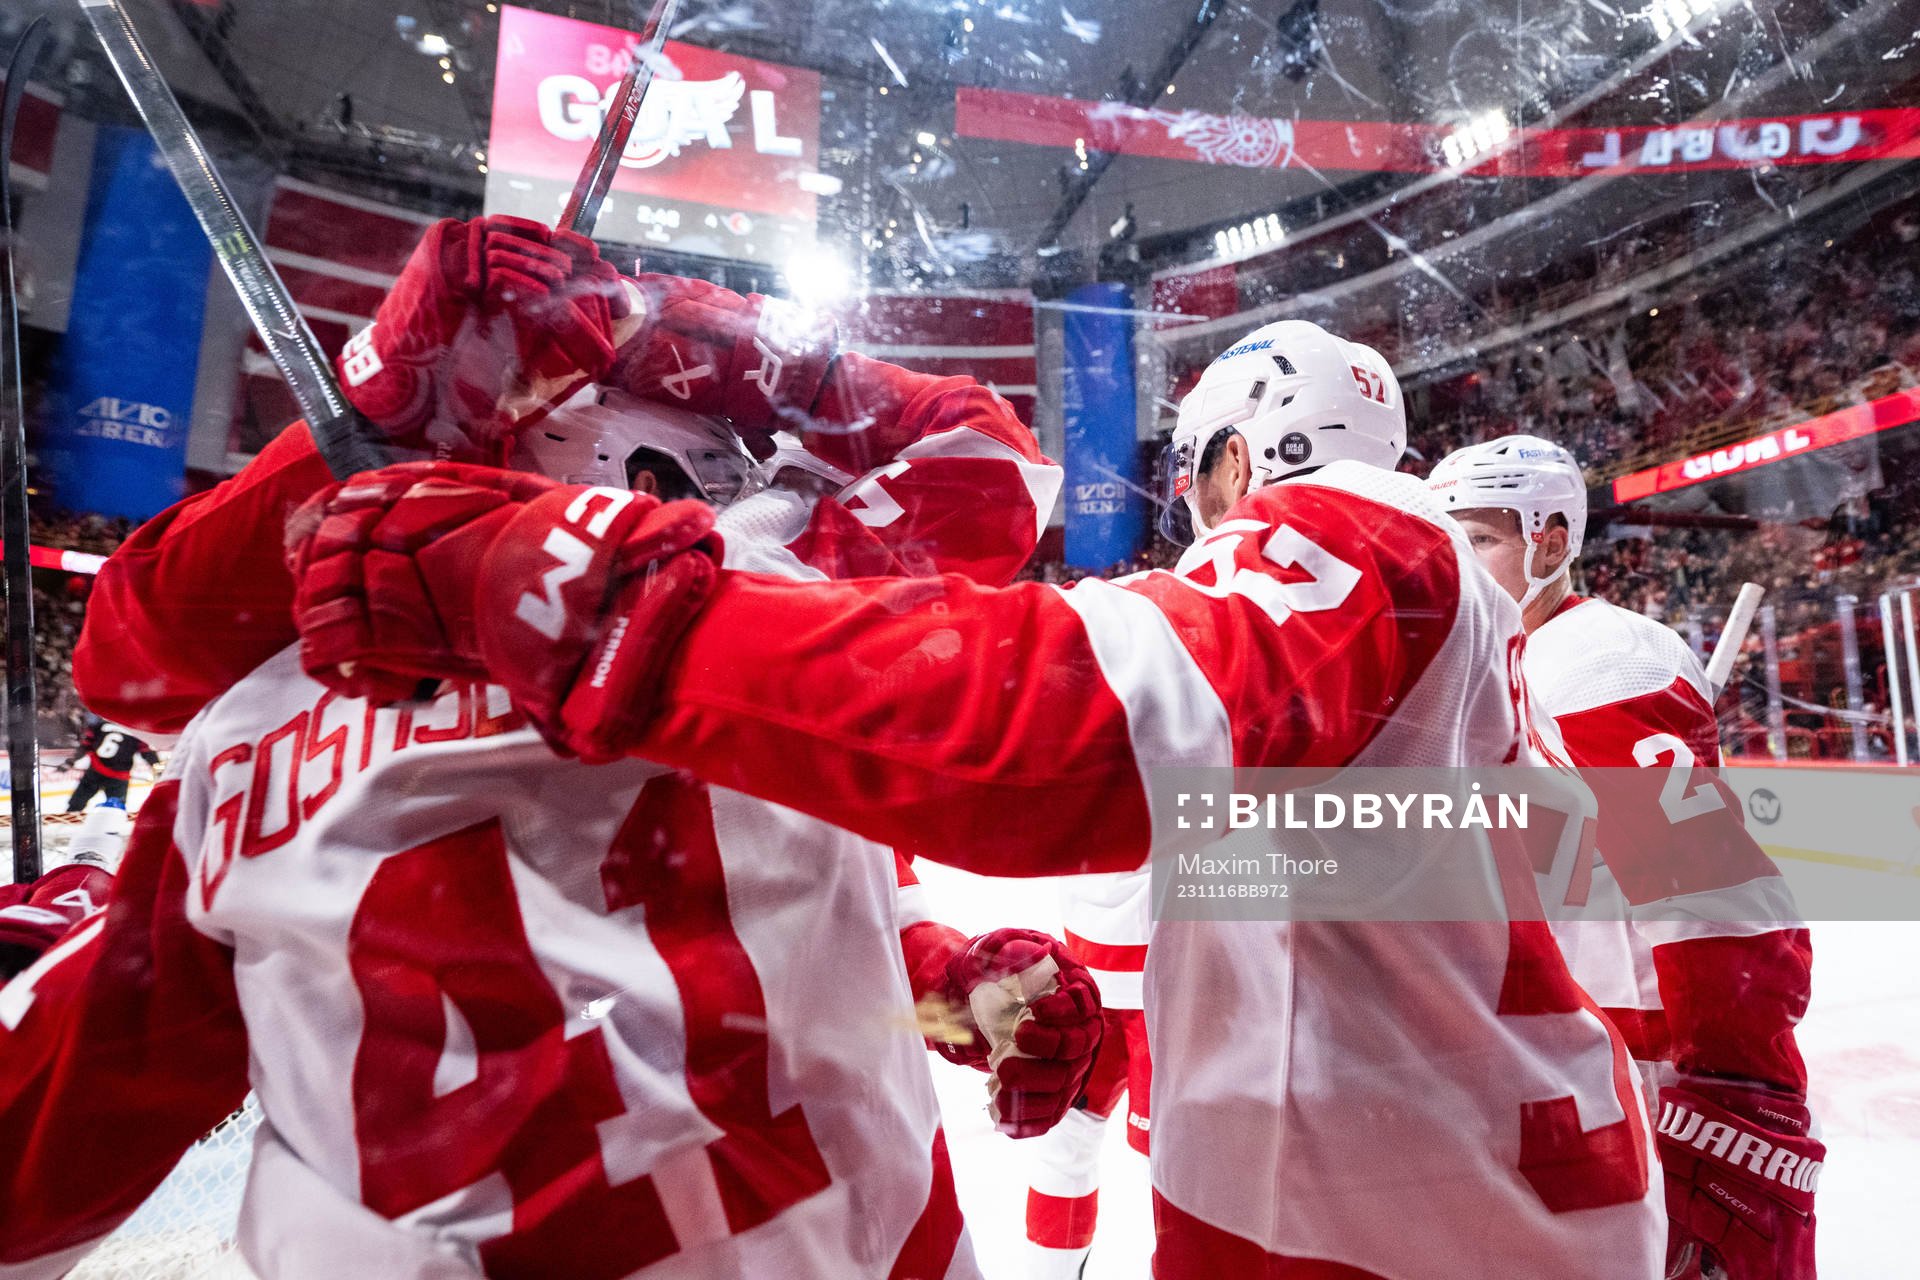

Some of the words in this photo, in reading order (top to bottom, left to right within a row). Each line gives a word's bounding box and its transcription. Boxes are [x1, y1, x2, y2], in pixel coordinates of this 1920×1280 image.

[1351, 366, 1385, 404] 57
[515, 486, 636, 641] CM
[96, 733, 124, 759] 6
[1631, 733, 1726, 825] 2
[348, 770, 833, 1280] 41
[1657, 1101, 1824, 1194] WARRIO
[1708, 1181, 1757, 1216] COVERT
